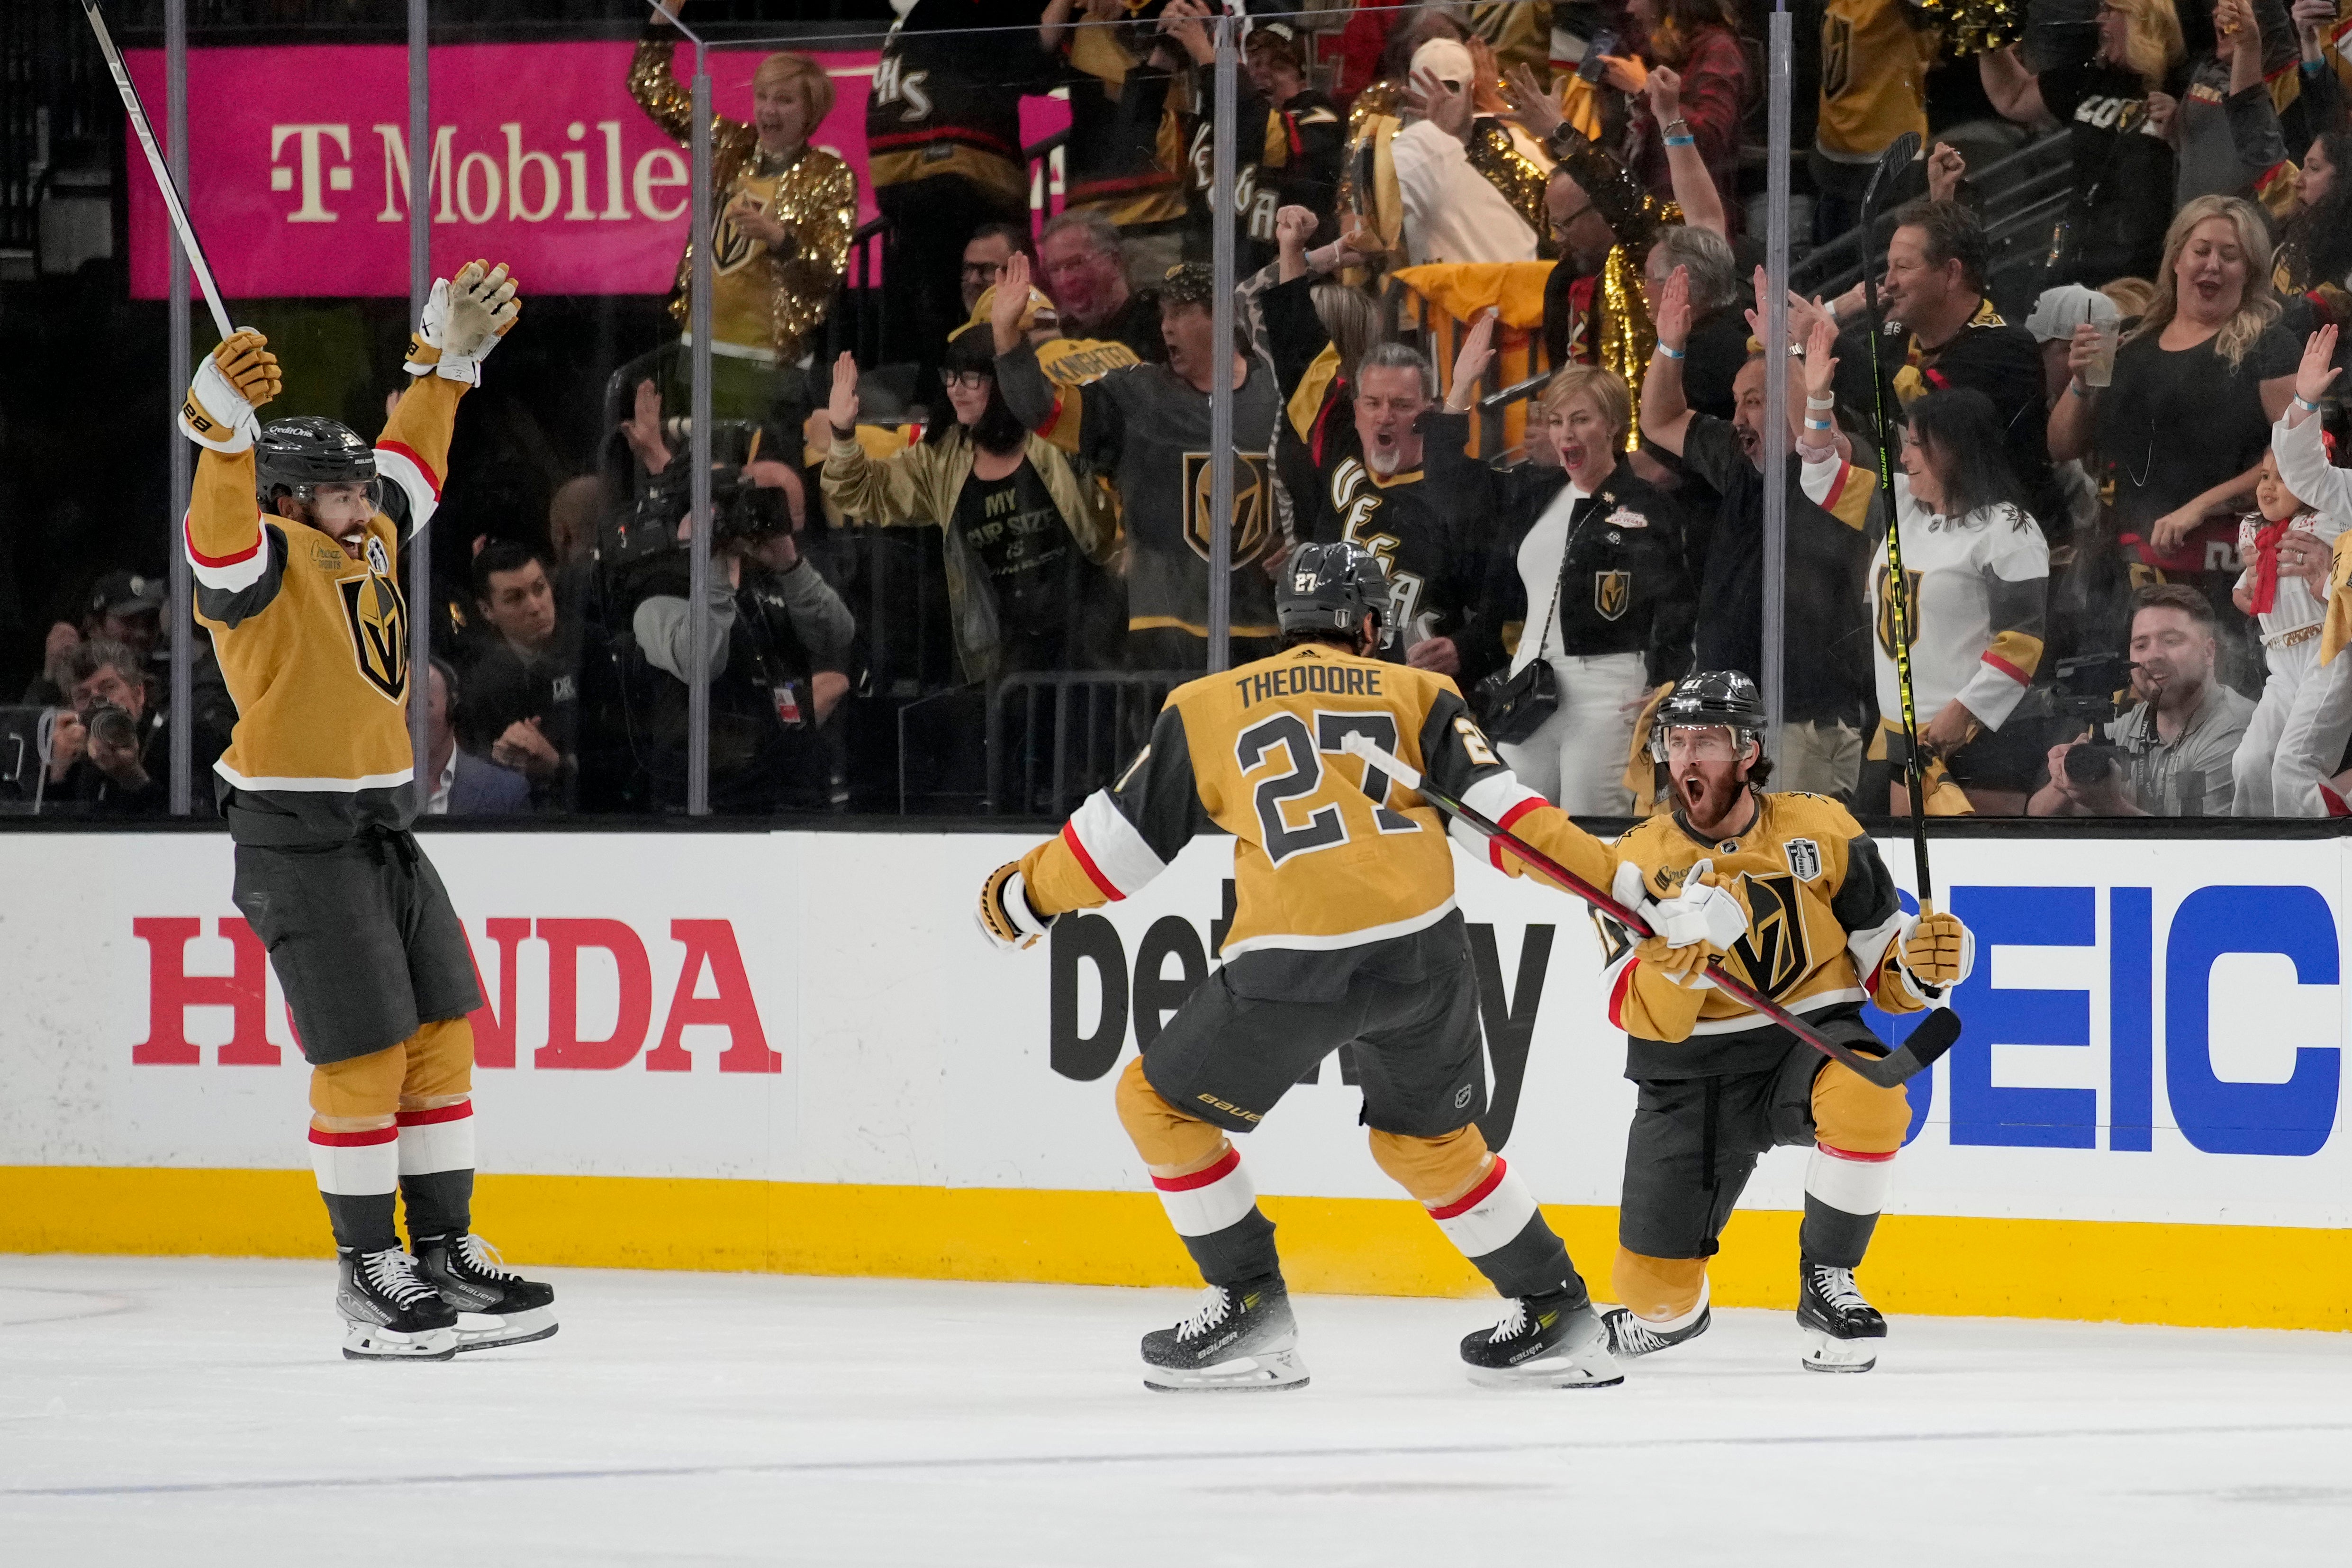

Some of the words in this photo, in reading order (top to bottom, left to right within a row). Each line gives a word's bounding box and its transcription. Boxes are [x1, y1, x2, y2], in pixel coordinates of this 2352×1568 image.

[271, 124, 352, 223] T
[373, 121, 689, 223] Mobile
[985, 488, 1016, 518] MY
[1295, 573, 1317, 592] 27
[1236, 665, 1382, 709] THEODORE
[1454, 717, 1501, 766] 2
[1234, 709, 1423, 870] 27
[133, 917, 782, 1074] HNDA
[1196, 1093, 1263, 1123] BAUE
